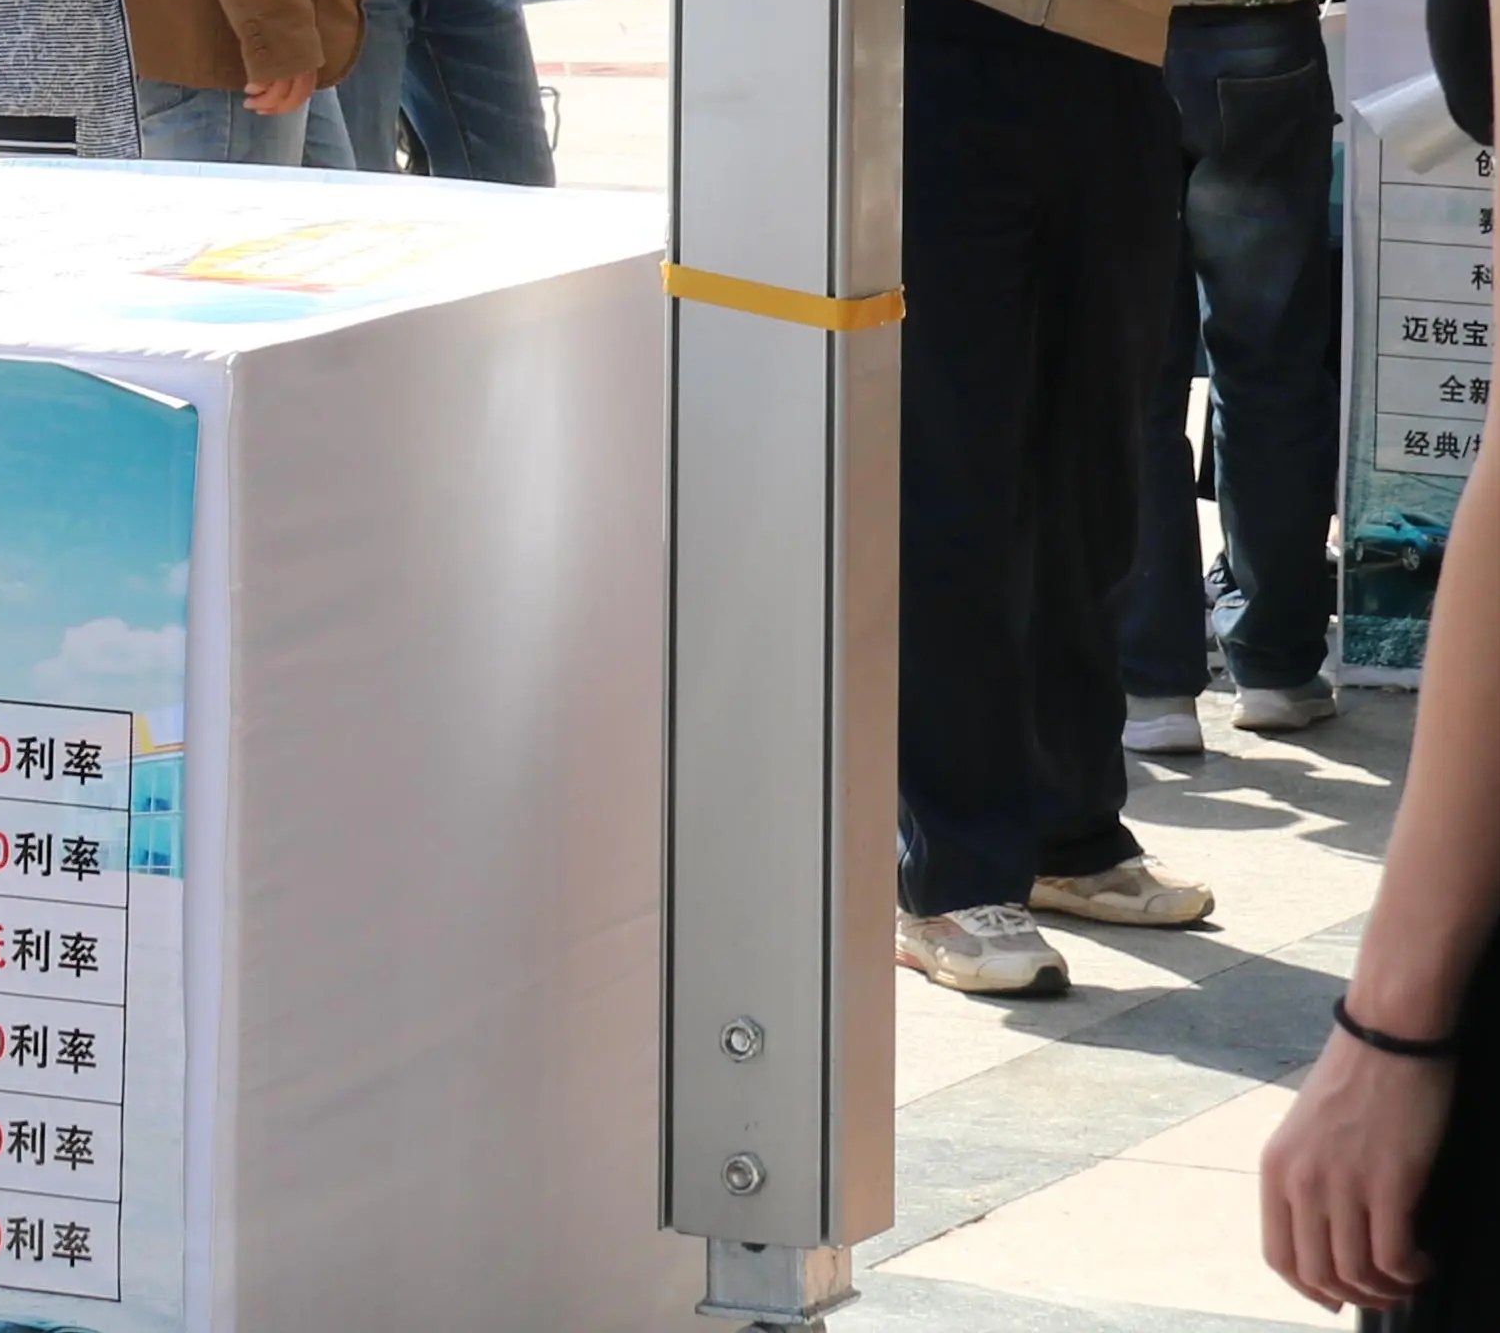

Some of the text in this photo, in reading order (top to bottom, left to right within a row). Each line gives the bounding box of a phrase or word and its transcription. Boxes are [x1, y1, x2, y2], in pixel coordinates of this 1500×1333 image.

[1402, 315, 1488, 347] 迈锐宝
[1440, 375, 1489, 404] 全新
[1404, 430, 1471, 460] 经典/
